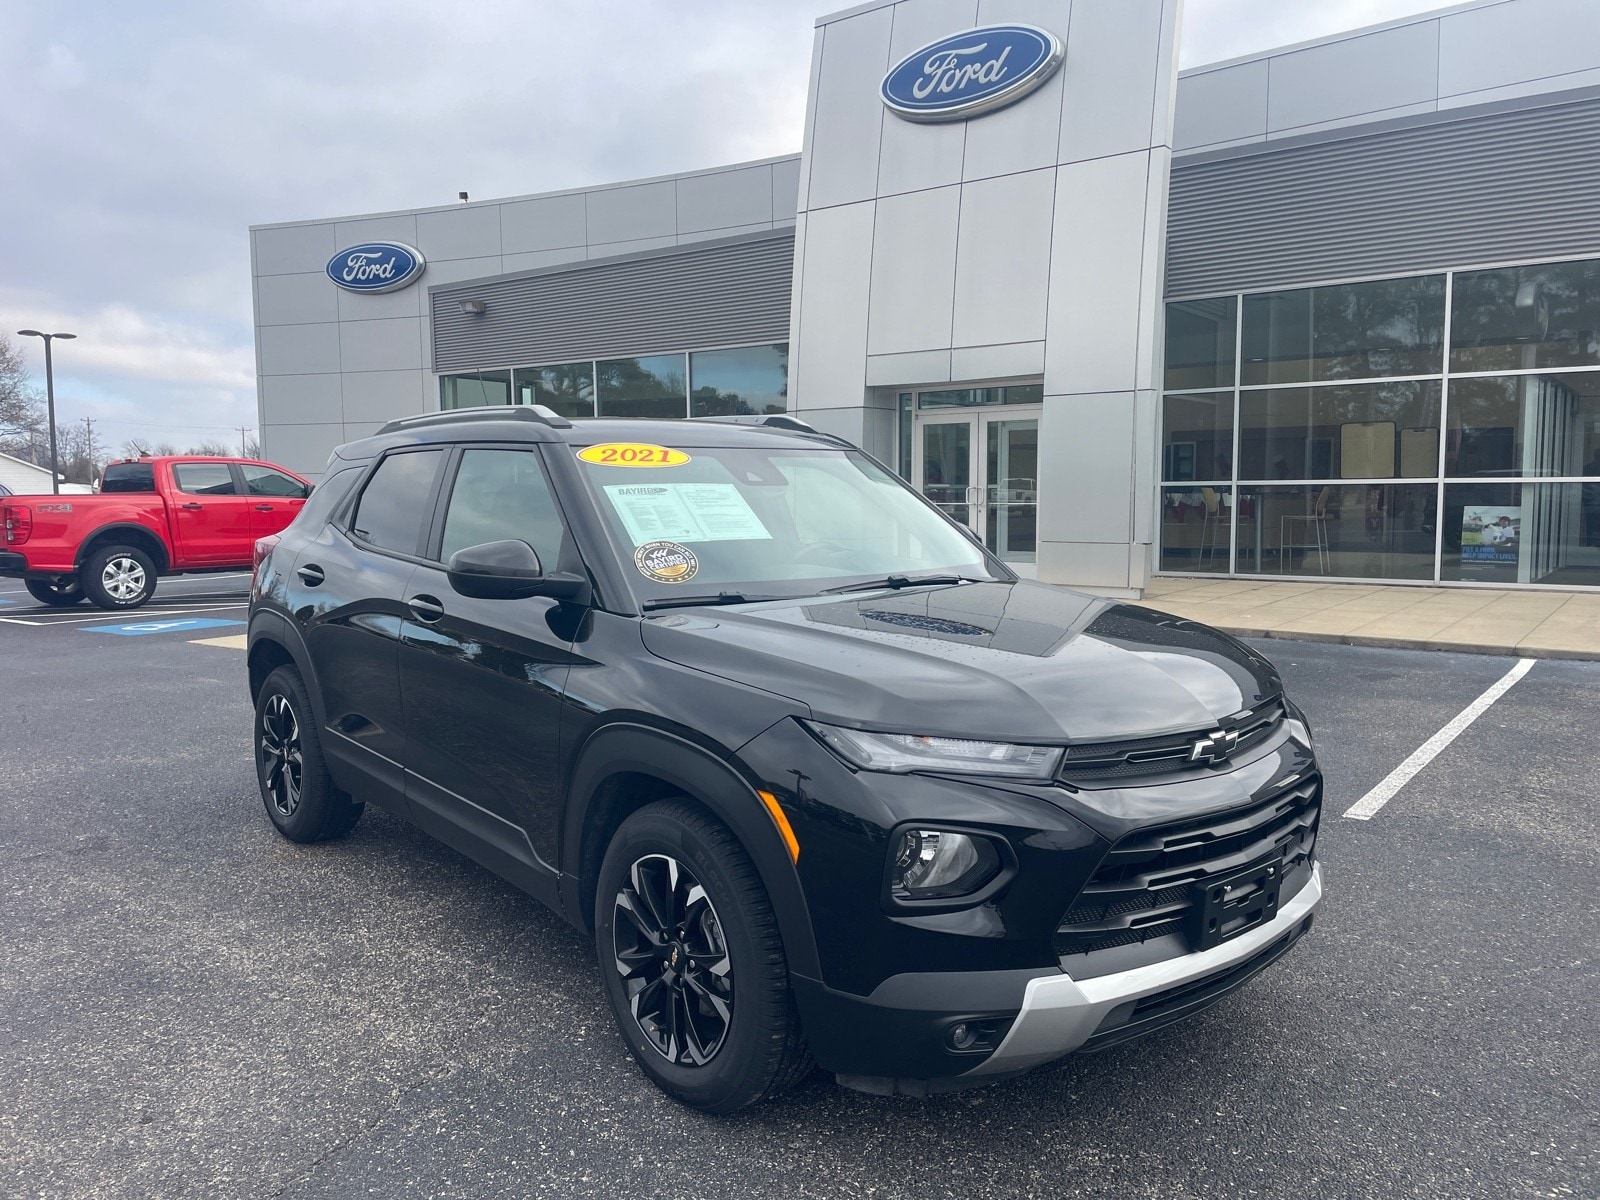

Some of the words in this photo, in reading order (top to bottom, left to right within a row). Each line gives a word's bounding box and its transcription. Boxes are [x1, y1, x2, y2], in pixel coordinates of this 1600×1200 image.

[913, 43, 1012, 99] Ford
[343, 252, 396, 281] Ford
[600, 448, 671, 463] 2021
[618, 487, 655, 496] BAYIRD
[36, 503, 73, 513] FX4
[645, 554, 683, 567] BAYIRD
[649, 560, 687, 570] CERTIFIED
